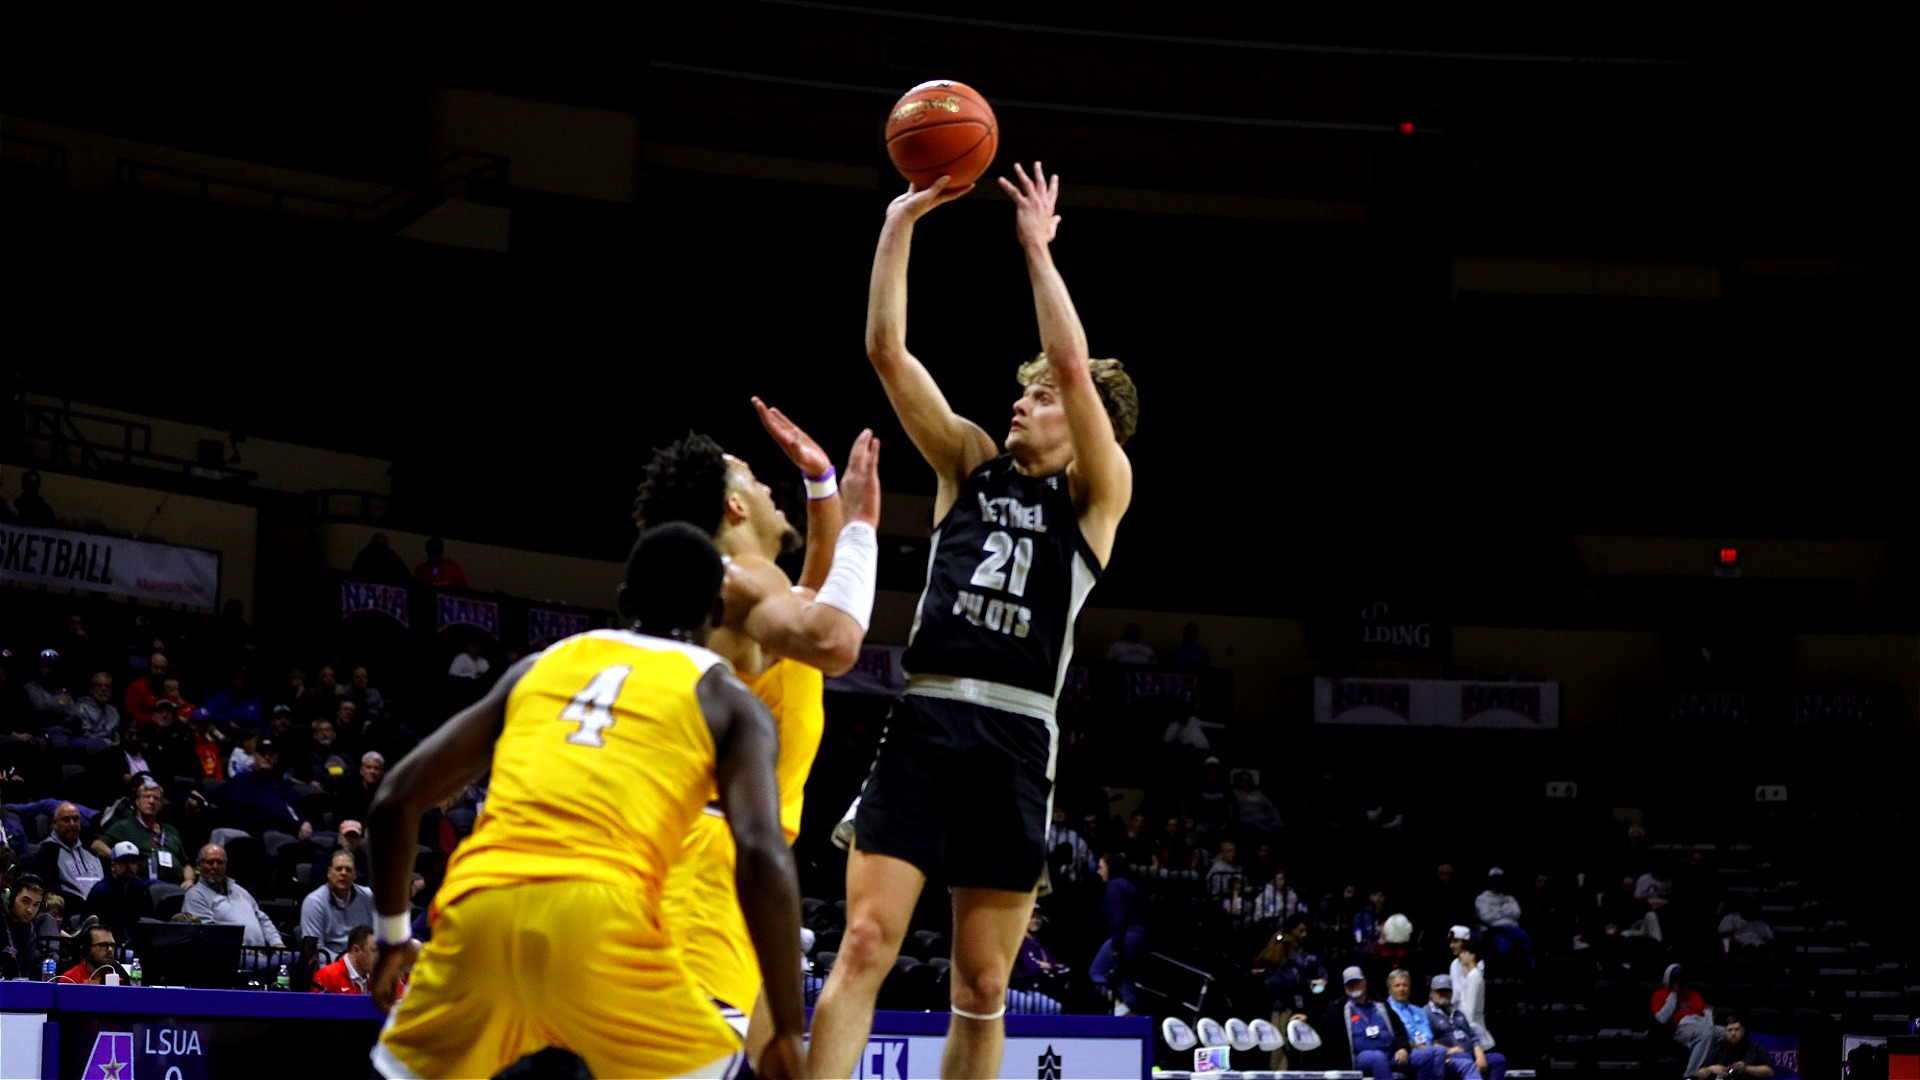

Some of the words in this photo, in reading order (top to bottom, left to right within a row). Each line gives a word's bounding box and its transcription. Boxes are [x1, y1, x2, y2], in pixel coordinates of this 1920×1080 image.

[970, 530, 1034, 597] 21
[344, 582, 408, 625] NAIA
[439, 597, 498, 637] NAIA
[952, 589, 1032, 638] PILOTS
[558, 664, 633, 748] 4
[1127, 672, 1198, 705] NAIA
[1333, 683, 1409, 717] NAIA
[1463, 686, 1539, 720] NAIA
[145, 1028, 201, 1055] LSUA
[853, 1042, 905, 1080] CK
